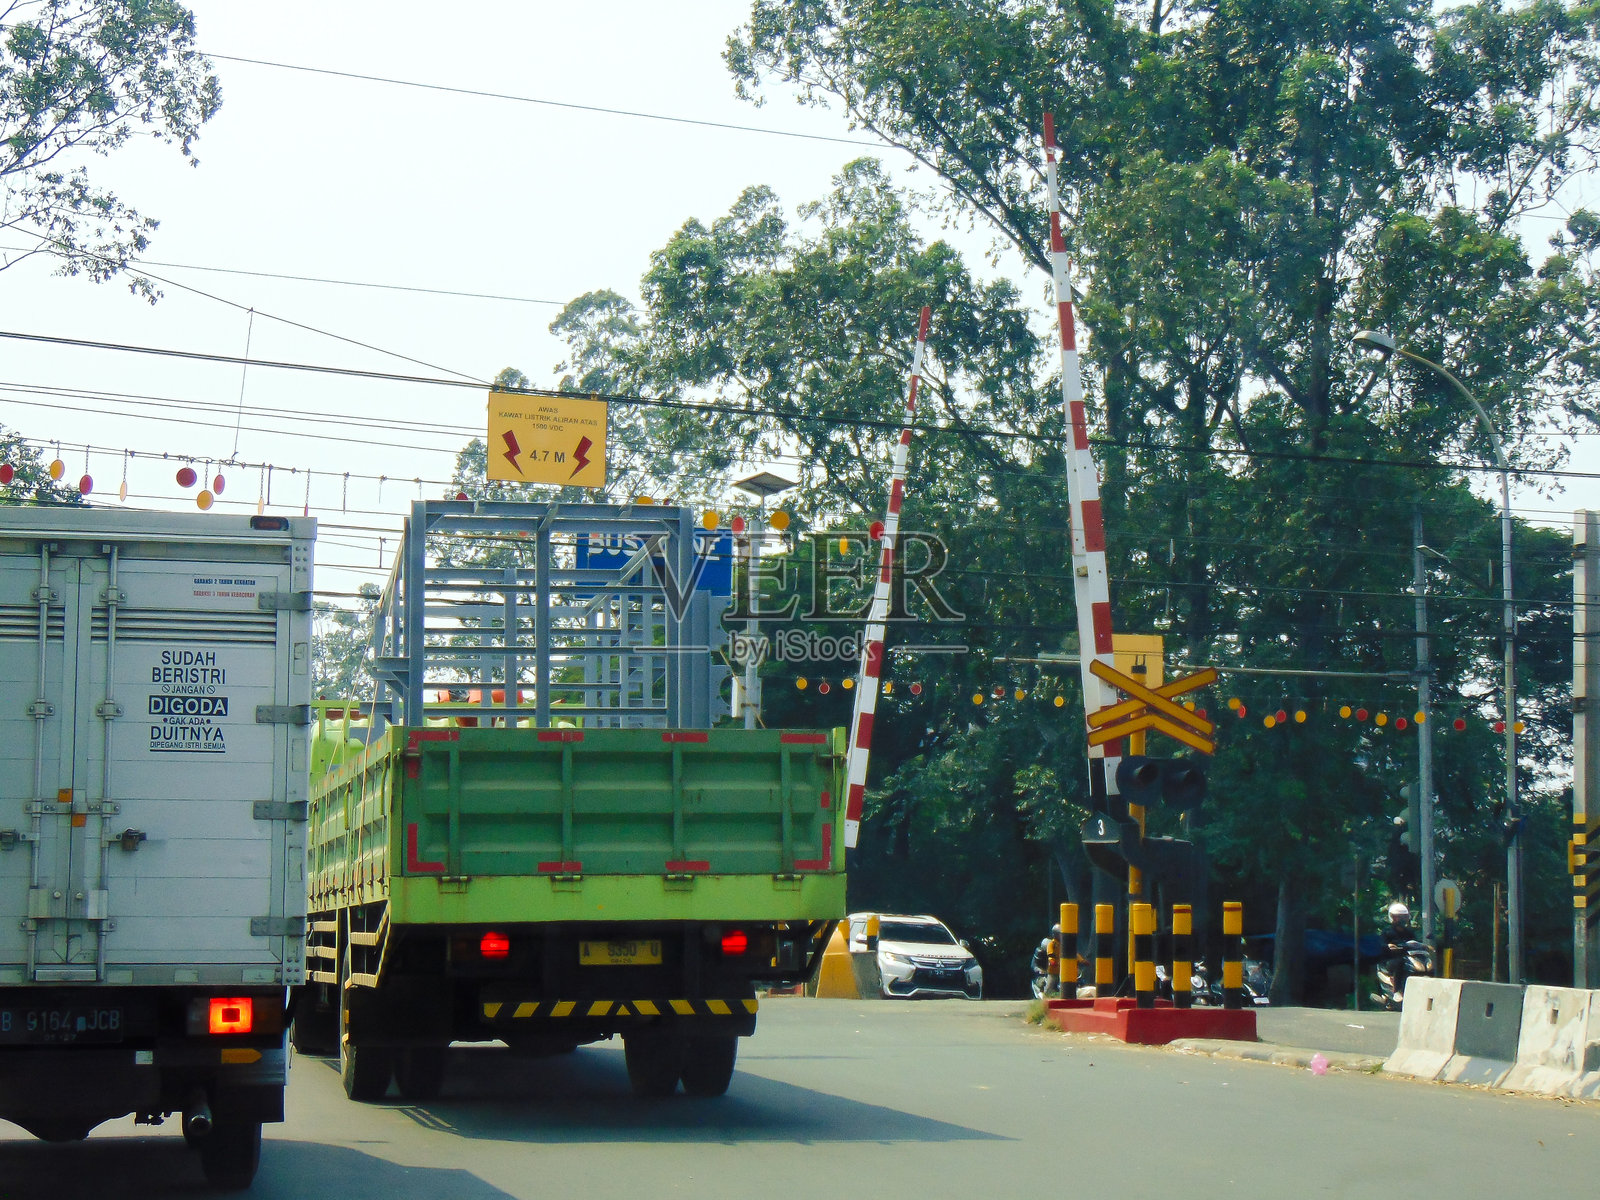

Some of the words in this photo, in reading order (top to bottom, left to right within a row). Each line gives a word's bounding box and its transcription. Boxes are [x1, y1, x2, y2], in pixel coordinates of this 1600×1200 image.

[498, 411, 522, 419] KAWAT
[524, 413, 552, 422] LISTRIK
[552, 416, 579, 425] ALIRAN
[580, 418, 598, 427] ATAS
[550, 424, 564, 432] VDC
[529, 449, 550, 463] 4.7
[554, 451, 565, 464] M
[588, 532, 642, 557] BUS
[161, 650, 216, 666] SUDAH
[152, 667, 226, 684] BERISTRI
[171, 685, 205, 694] JANGAN
[150, 697, 227, 715] DIGODA
[169, 717, 187, 725] GAK
[188, 717, 206, 726] ADA
[150, 725, 224, 741] DUITNYA
[149, 741, 184, 749] DIPEGANG
[203, 742, 226, 750] SEMUA
[1097, 819, 1105, 836] 3
[2, 1011, 12, 1032] B
[26, 1010, 72, 1031] 9164
[87, 1009, 120, 1030] JCB
